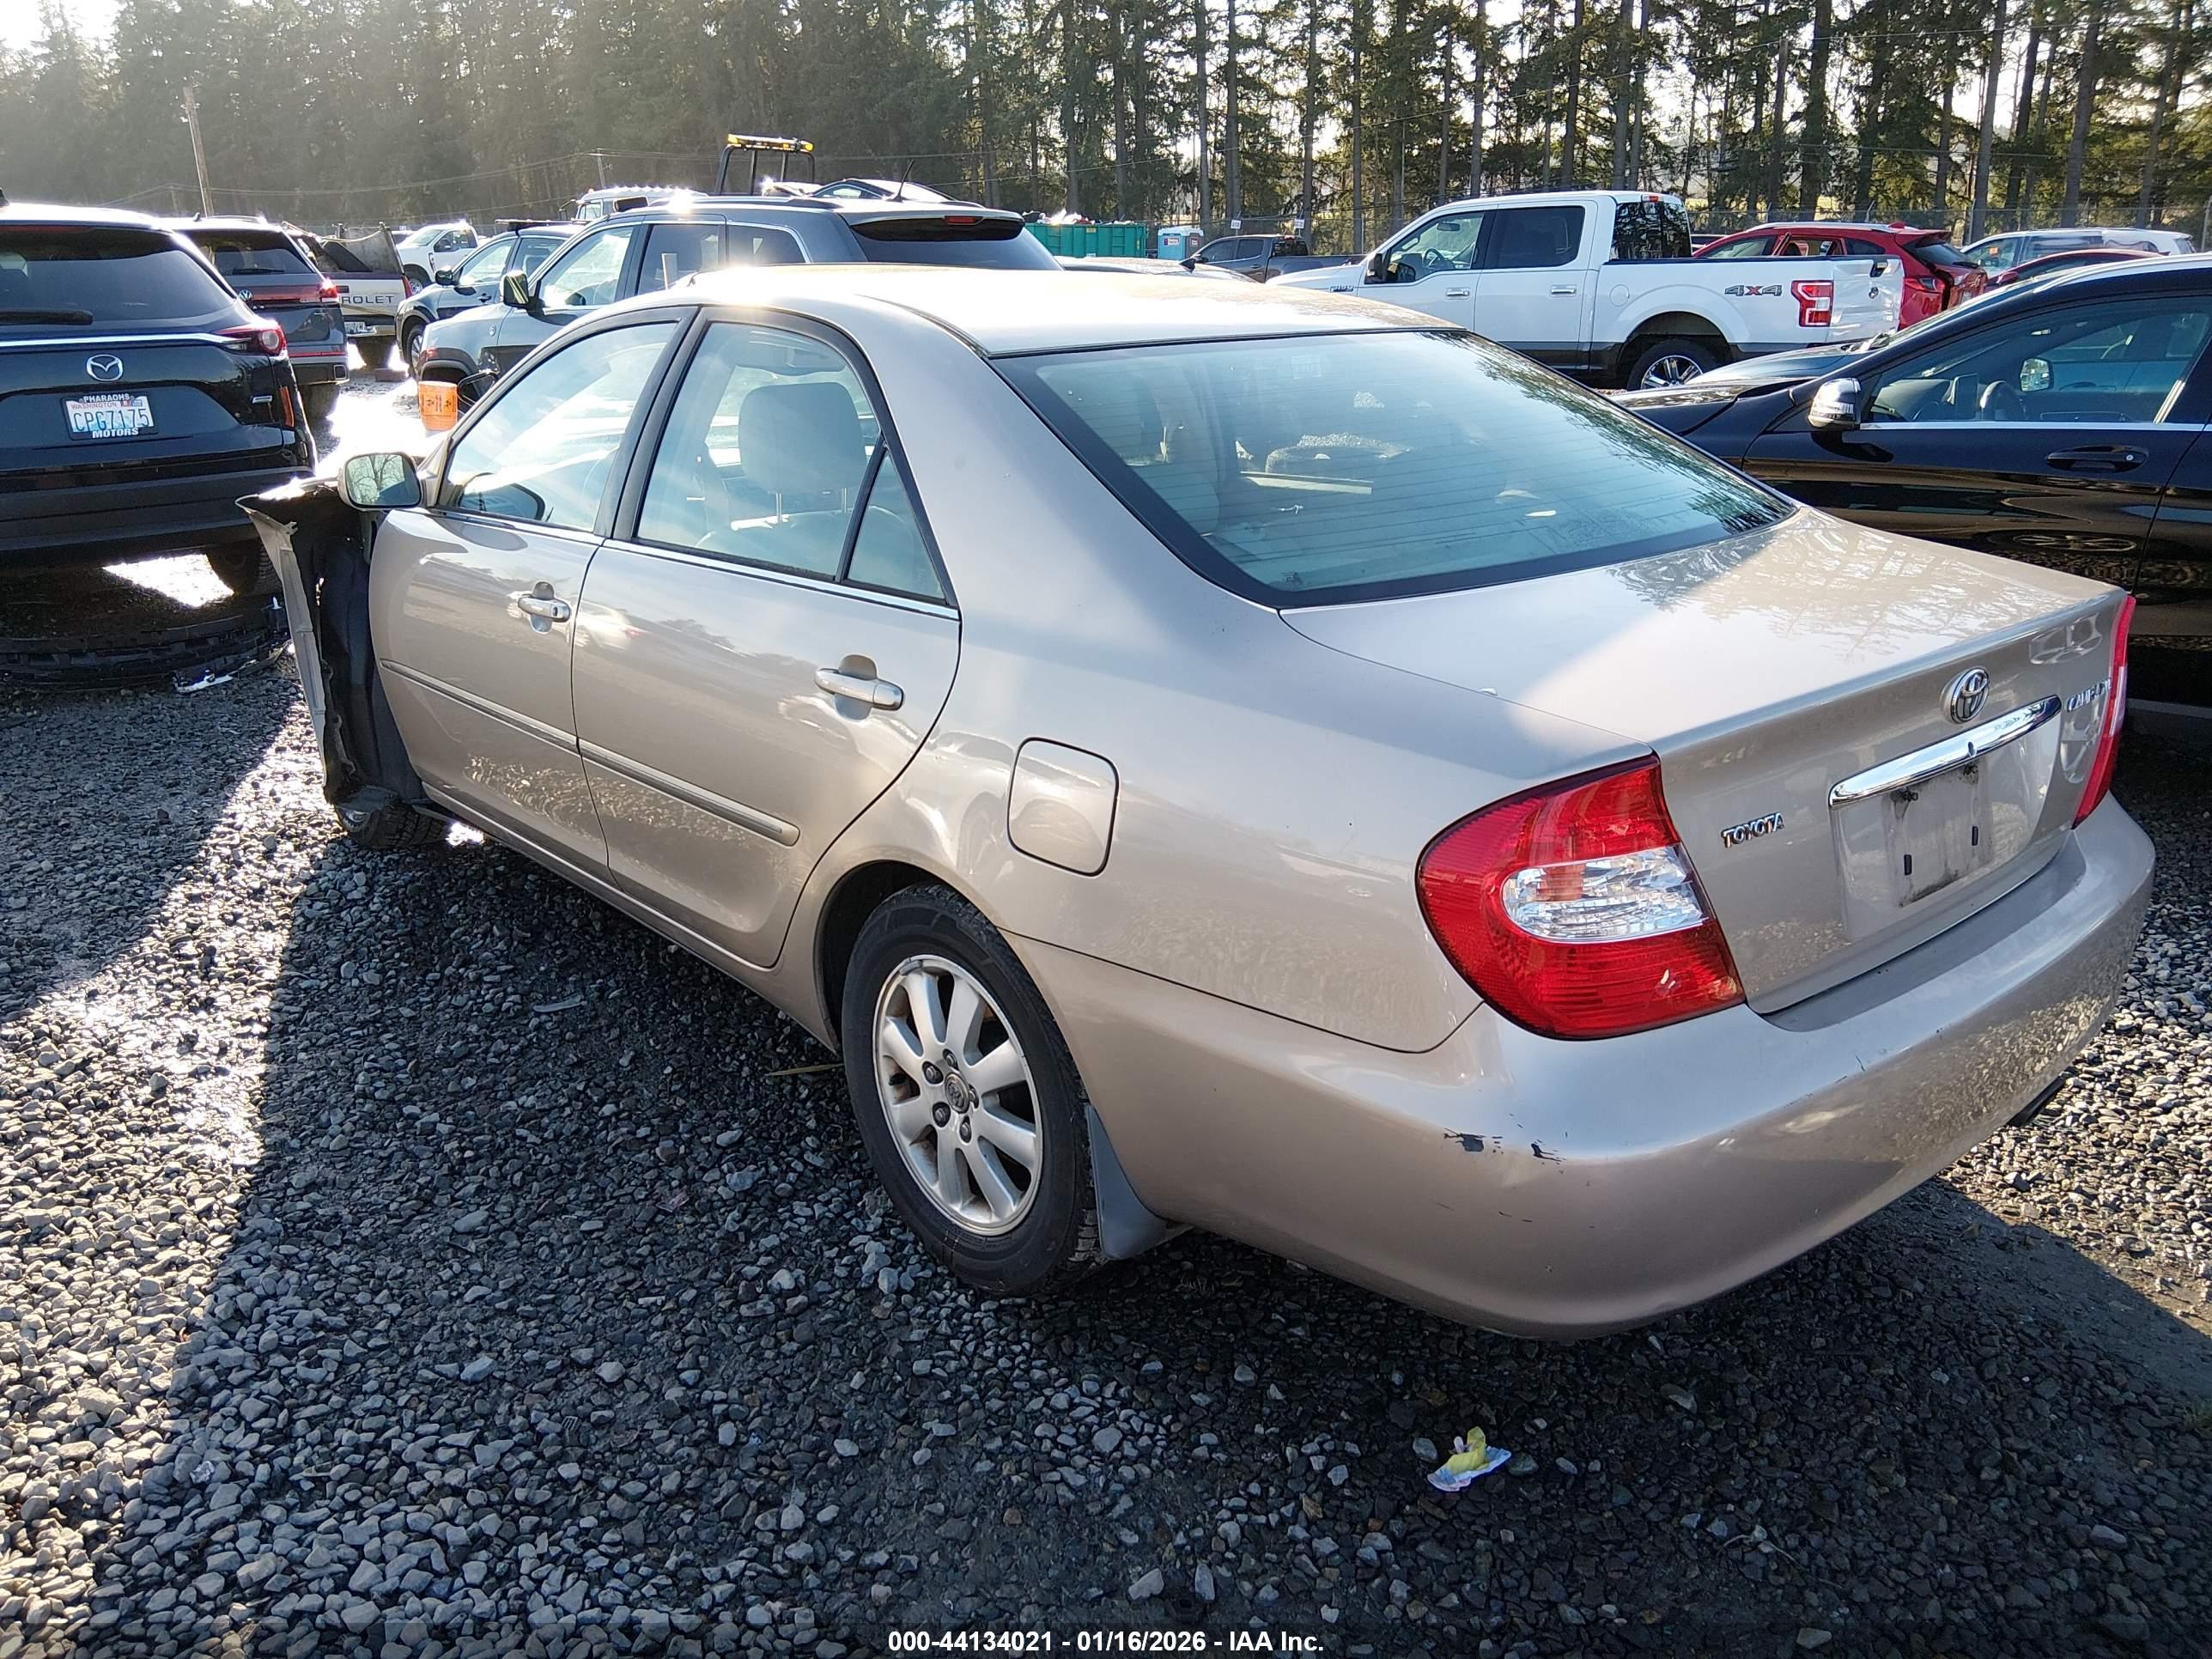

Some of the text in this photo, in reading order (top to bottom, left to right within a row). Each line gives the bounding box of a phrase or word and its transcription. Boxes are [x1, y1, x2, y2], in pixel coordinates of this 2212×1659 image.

[83, 393, 131, 403] PHARAOHS
[74, 408, 149, 432] CPG7175
[92, 428, 139, 439] MOTORS
[1721, 811, 1785, 848] TOYOTA
